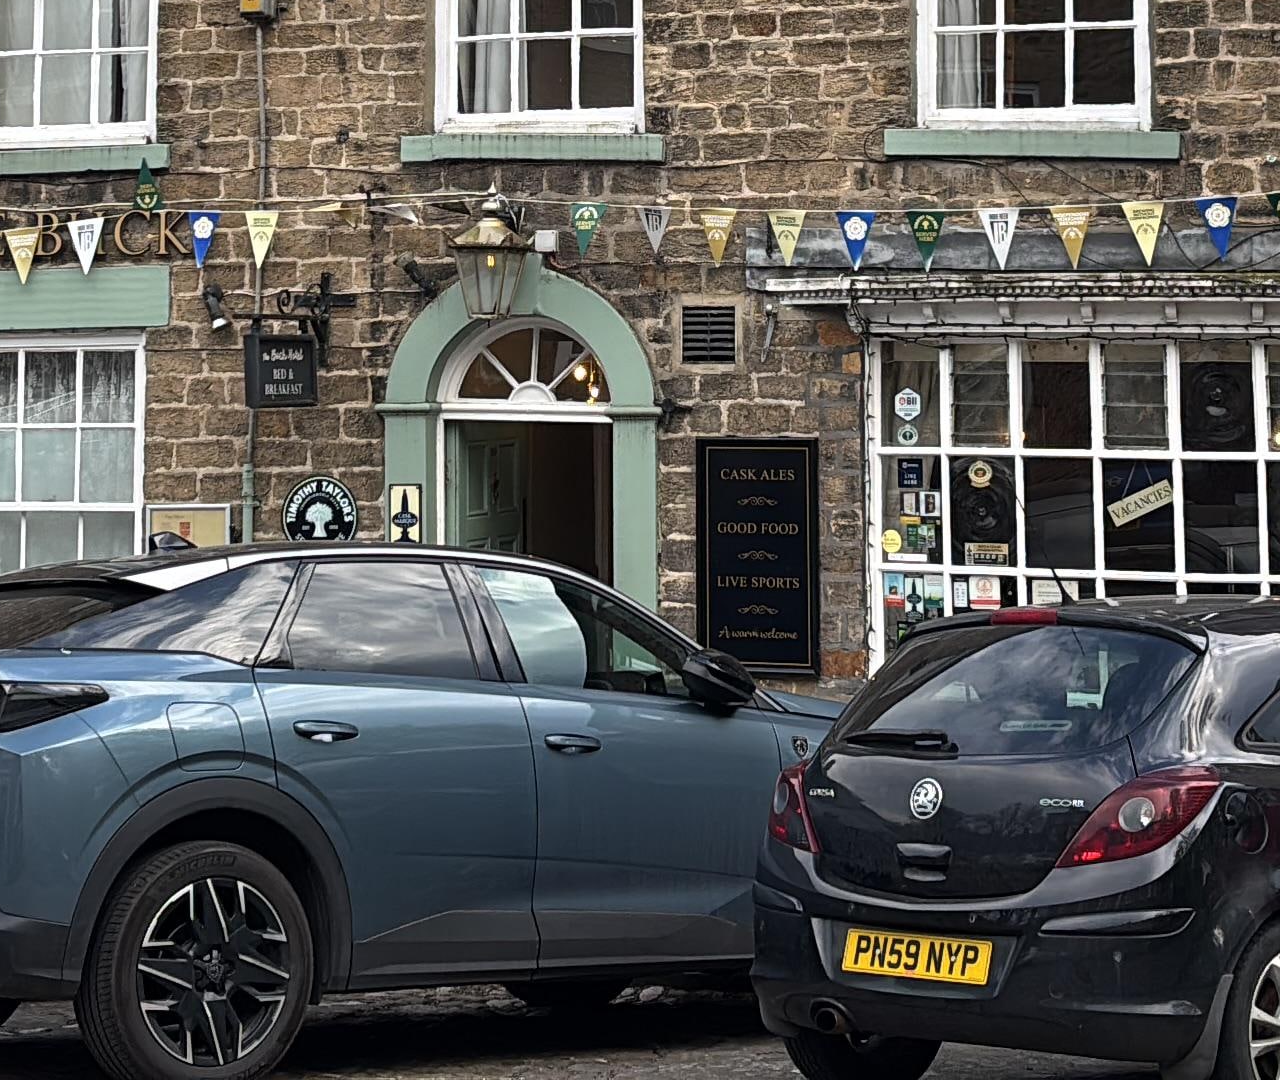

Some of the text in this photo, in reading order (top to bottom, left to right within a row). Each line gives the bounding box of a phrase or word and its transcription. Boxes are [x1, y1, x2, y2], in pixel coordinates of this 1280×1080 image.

[273, 368, 287, 379] BED
[264, 383, 303, 395] BREAKFAST
[720, 468, 795, 480] CASK ALES
[286, 481, 318, 523] TIMOTHY
[321, 481, 355, 522] TAYLOR'S
[1112, 485, 1172, 519] VACANCIES
[717, 522, 799, 535] GOOD FOOD
[717, 575, 800, 589] LIVE SPORTS
[718, 625, 730, 639] A
[760, 627, 798, 639] welcome
[853, 934, 980, 977] PN59 NYP
